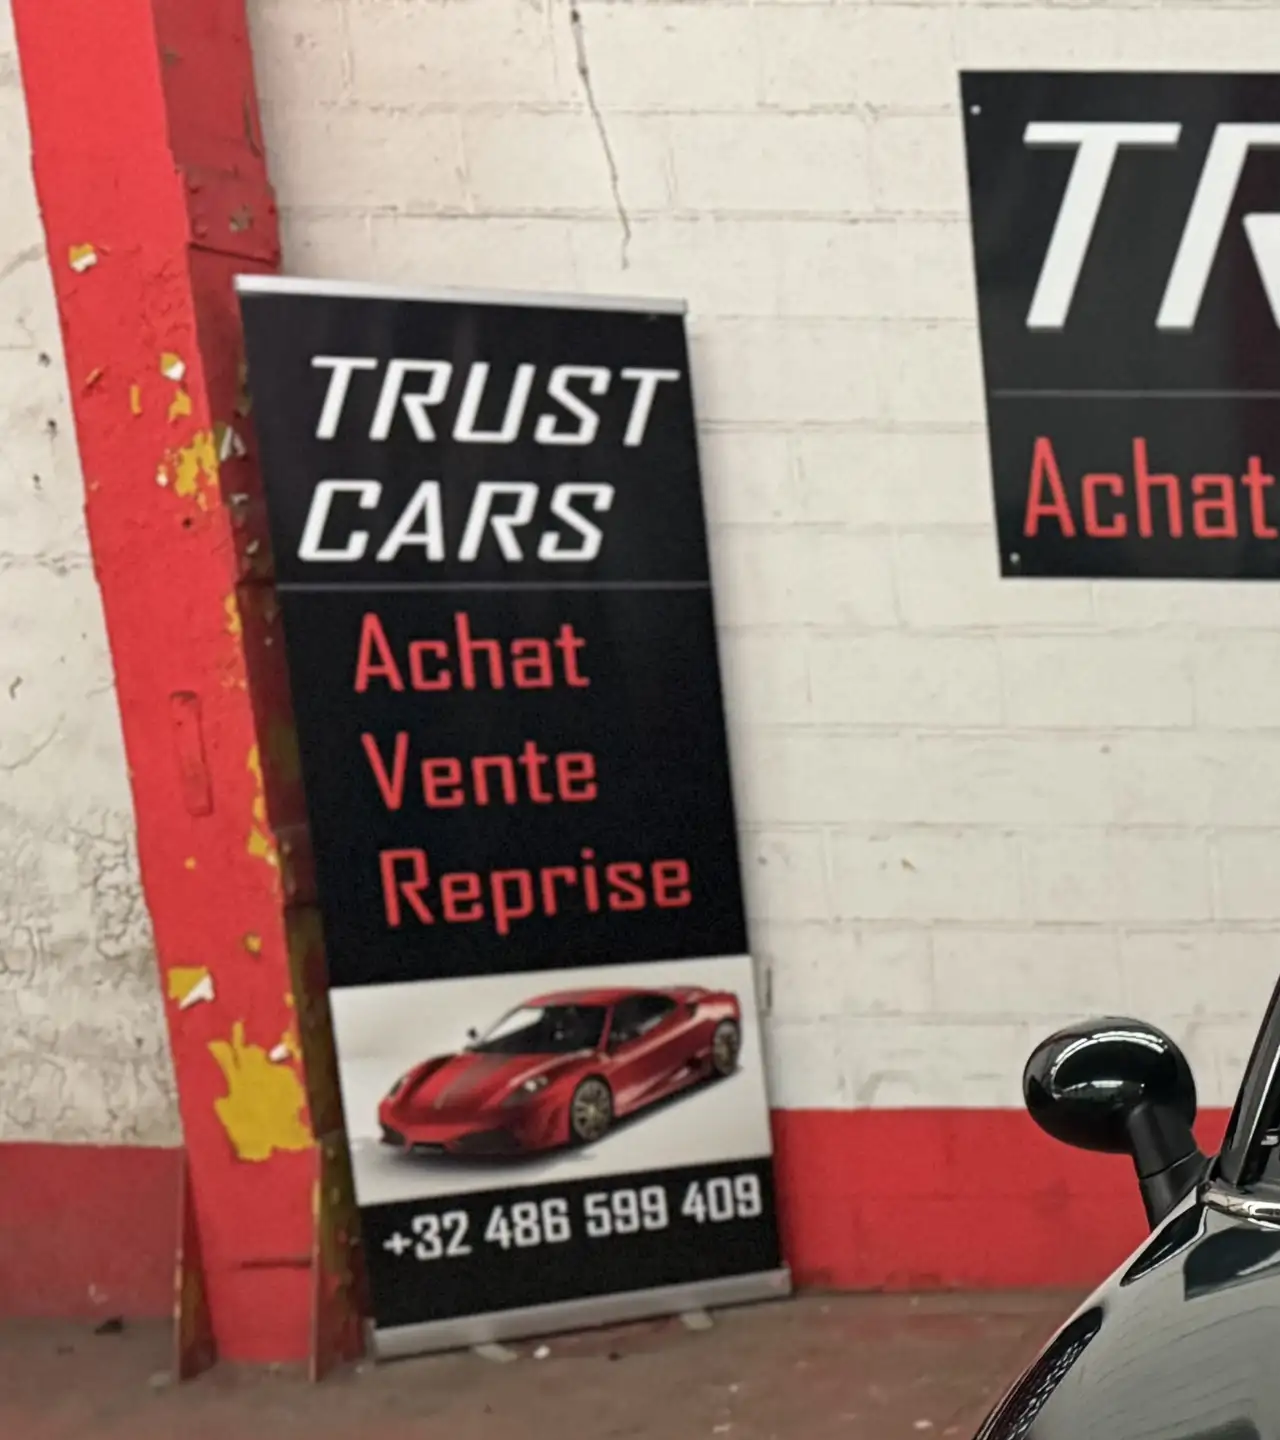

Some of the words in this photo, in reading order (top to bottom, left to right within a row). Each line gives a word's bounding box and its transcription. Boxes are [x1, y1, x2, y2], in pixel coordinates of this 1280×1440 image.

[310, 355, 680, 447] TRUST
[296, 478, 616, 563] CARS
[1023, 436, 1279, 540] Achat
[353, 611, 589, 694] Achat
[360, 730, 598, 812] Vente
[378, 848, 693, 936] Reprise
[383, 1210, 472, 1261] +32
[484, 1198, 571, 1250] 486
[584, 1185, 669, 1237] 599
[681, 1174, 762, 1224] 409
